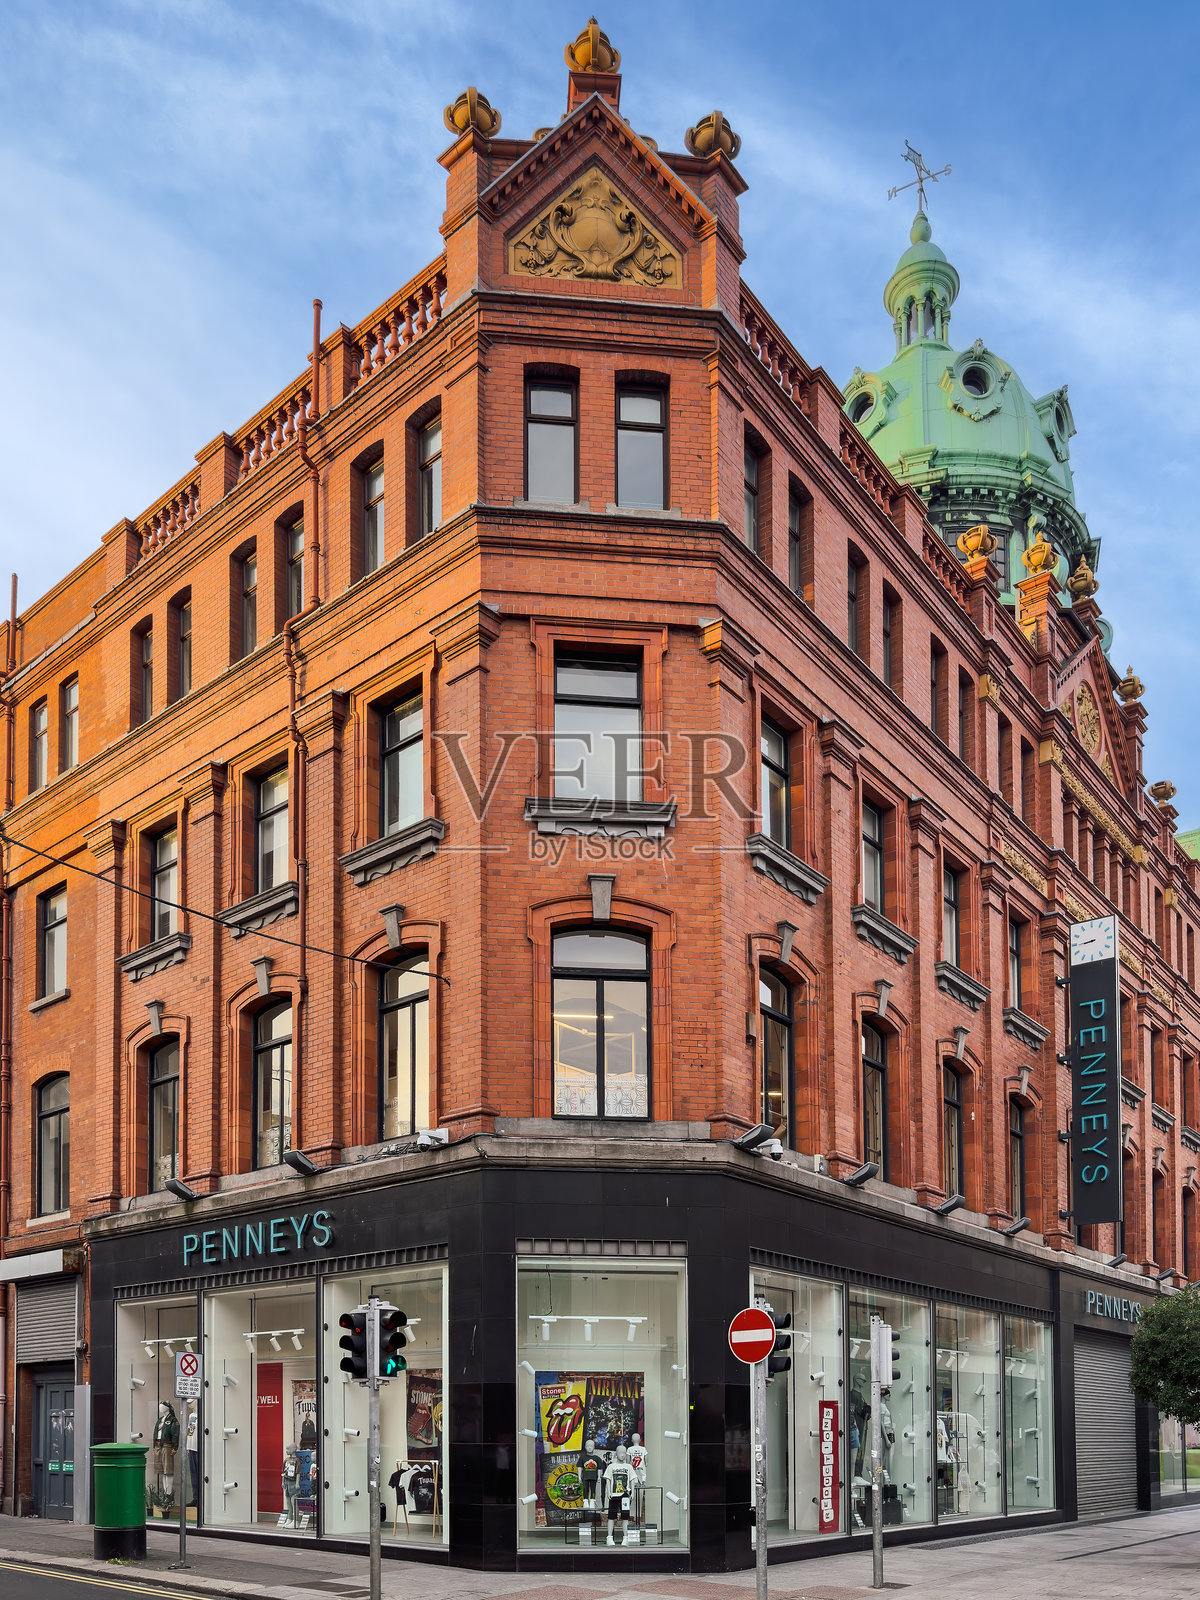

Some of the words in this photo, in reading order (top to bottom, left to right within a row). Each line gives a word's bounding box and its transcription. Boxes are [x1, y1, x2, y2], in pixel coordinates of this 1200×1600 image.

[1079, 999, 1109, 1184] PENNEYS
[183, 1210, 331, 1266] PENNEYS
[1087, 1290, 1141, 1324] PENNEYS
[296, 1400, 317, 1415] Tupa
[588, 1379, 639, 1398] NIRVANA
[823, 1410, 832, 1520] REDUCTIONS
